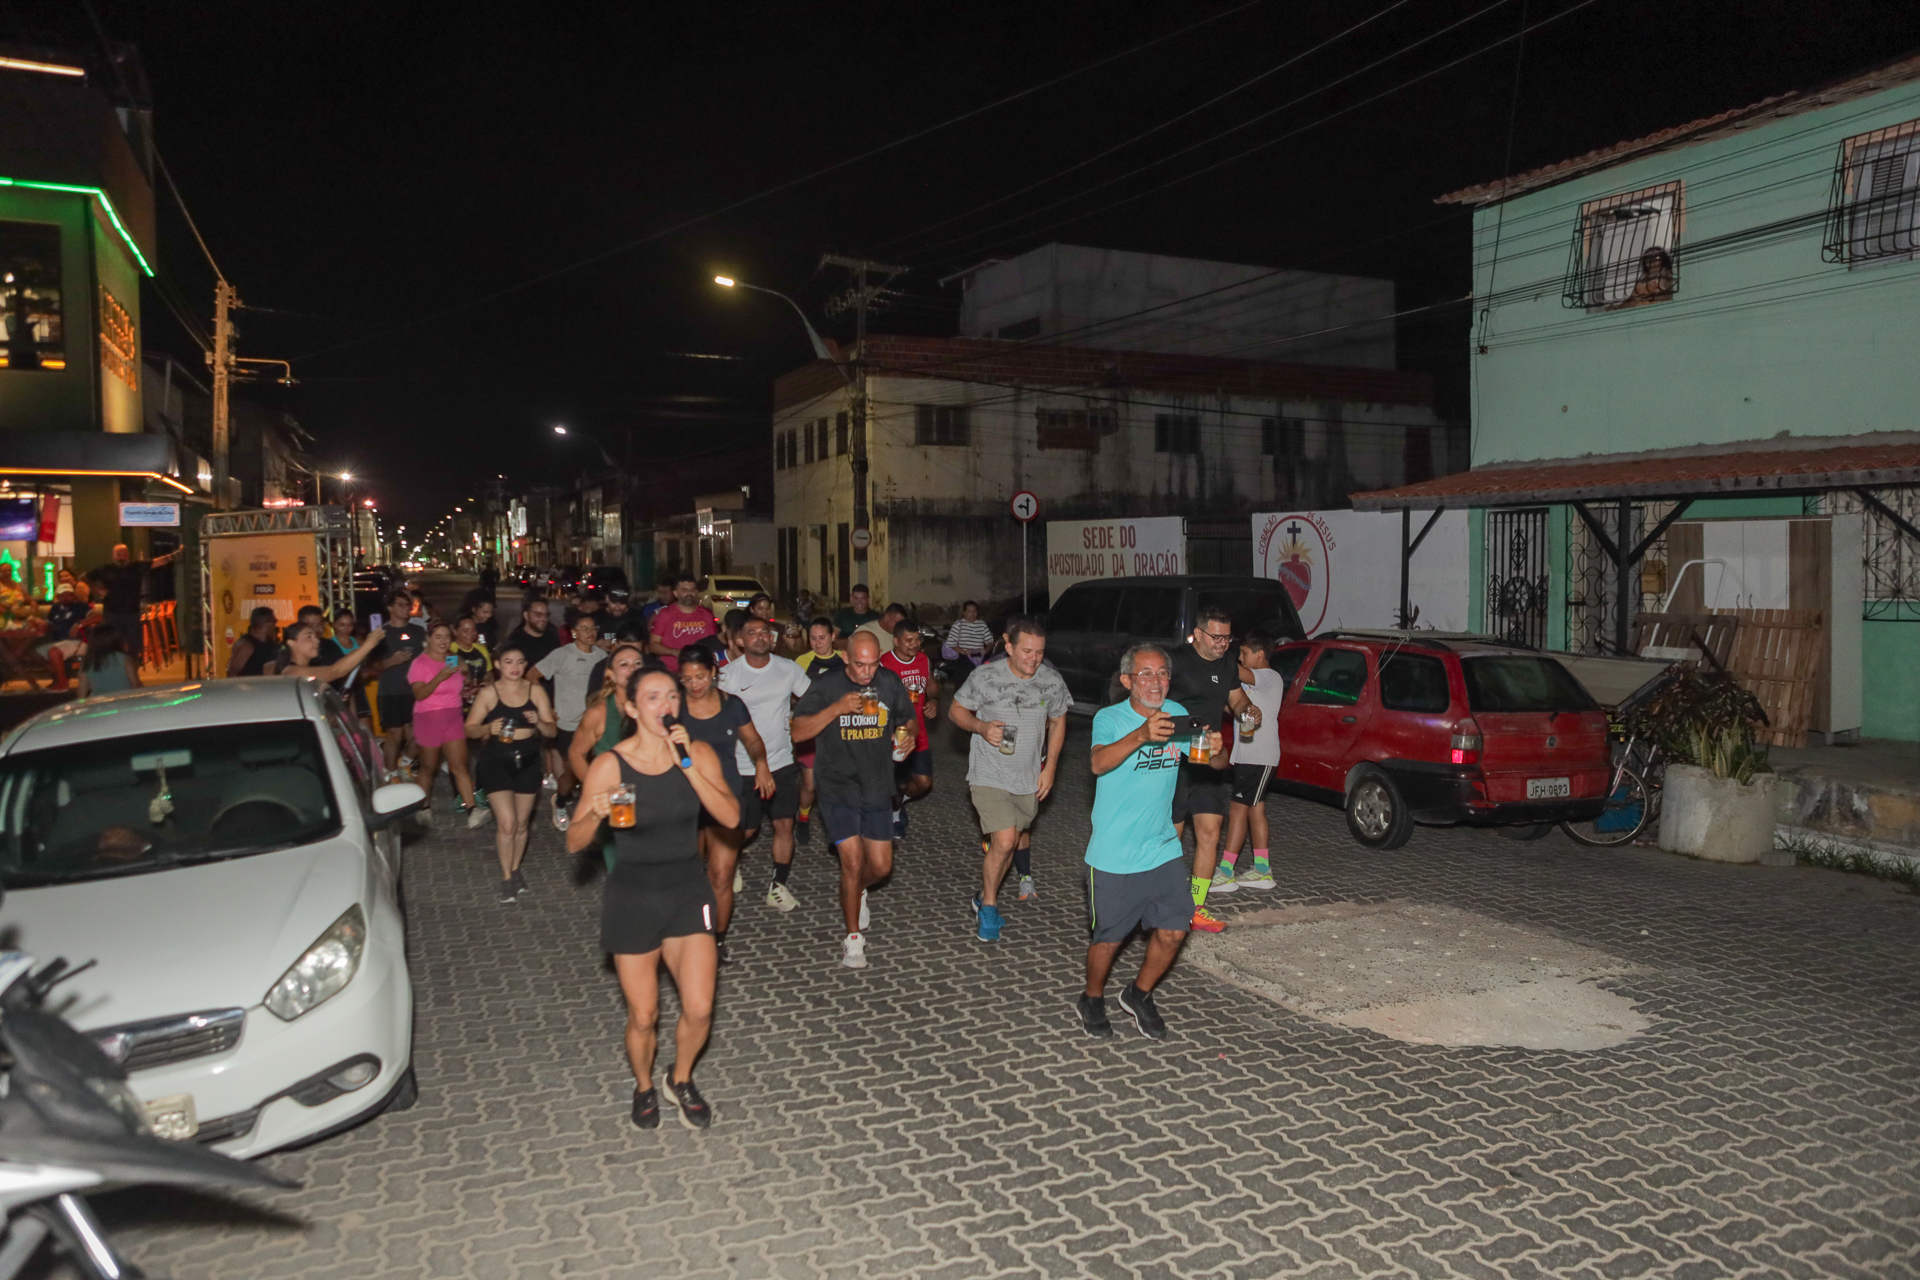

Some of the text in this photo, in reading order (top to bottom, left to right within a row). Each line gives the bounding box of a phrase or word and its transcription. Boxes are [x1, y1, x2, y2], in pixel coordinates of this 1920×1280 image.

[1082, 525, 1137, 550] SEDE DO
[1306, 511, 1336, 551] DE JESUS
[1048, 553, 1105, 577] APOSTOLADO
[1112, 553, 1127, 577] DA
[840, 715, 851, 727] EU
[847, 728, 864, 740] PRA
[1137, 746, 1164, 760] NO
